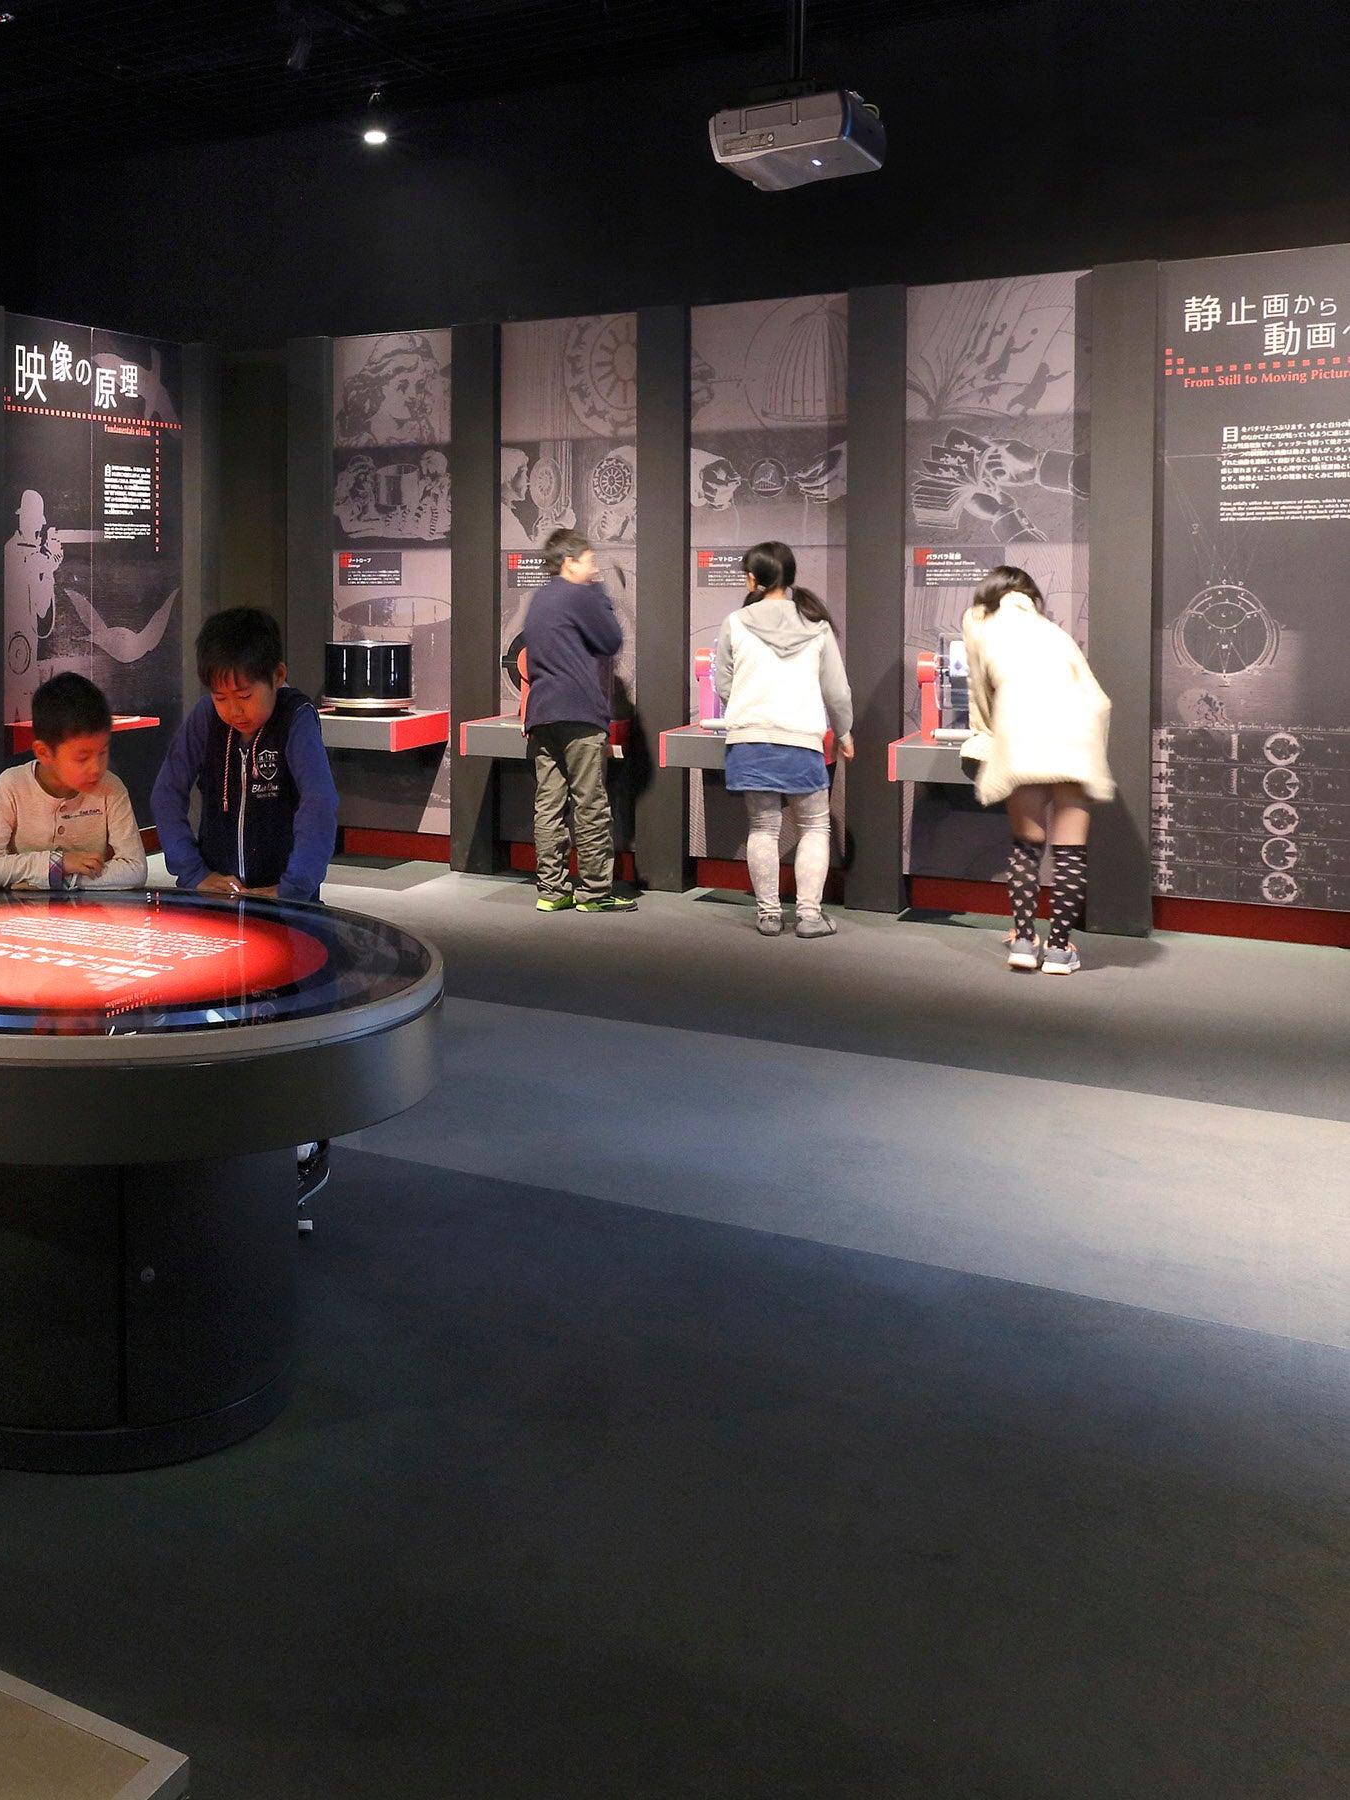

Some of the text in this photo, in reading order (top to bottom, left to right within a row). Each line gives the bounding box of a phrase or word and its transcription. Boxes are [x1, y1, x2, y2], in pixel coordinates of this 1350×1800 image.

[1183, 293, 1338, 333] 静止画から
[14, 340, 139, 409] 映像の原理
[1183, 368, 1350, 388] From Still to Moving Pictur
